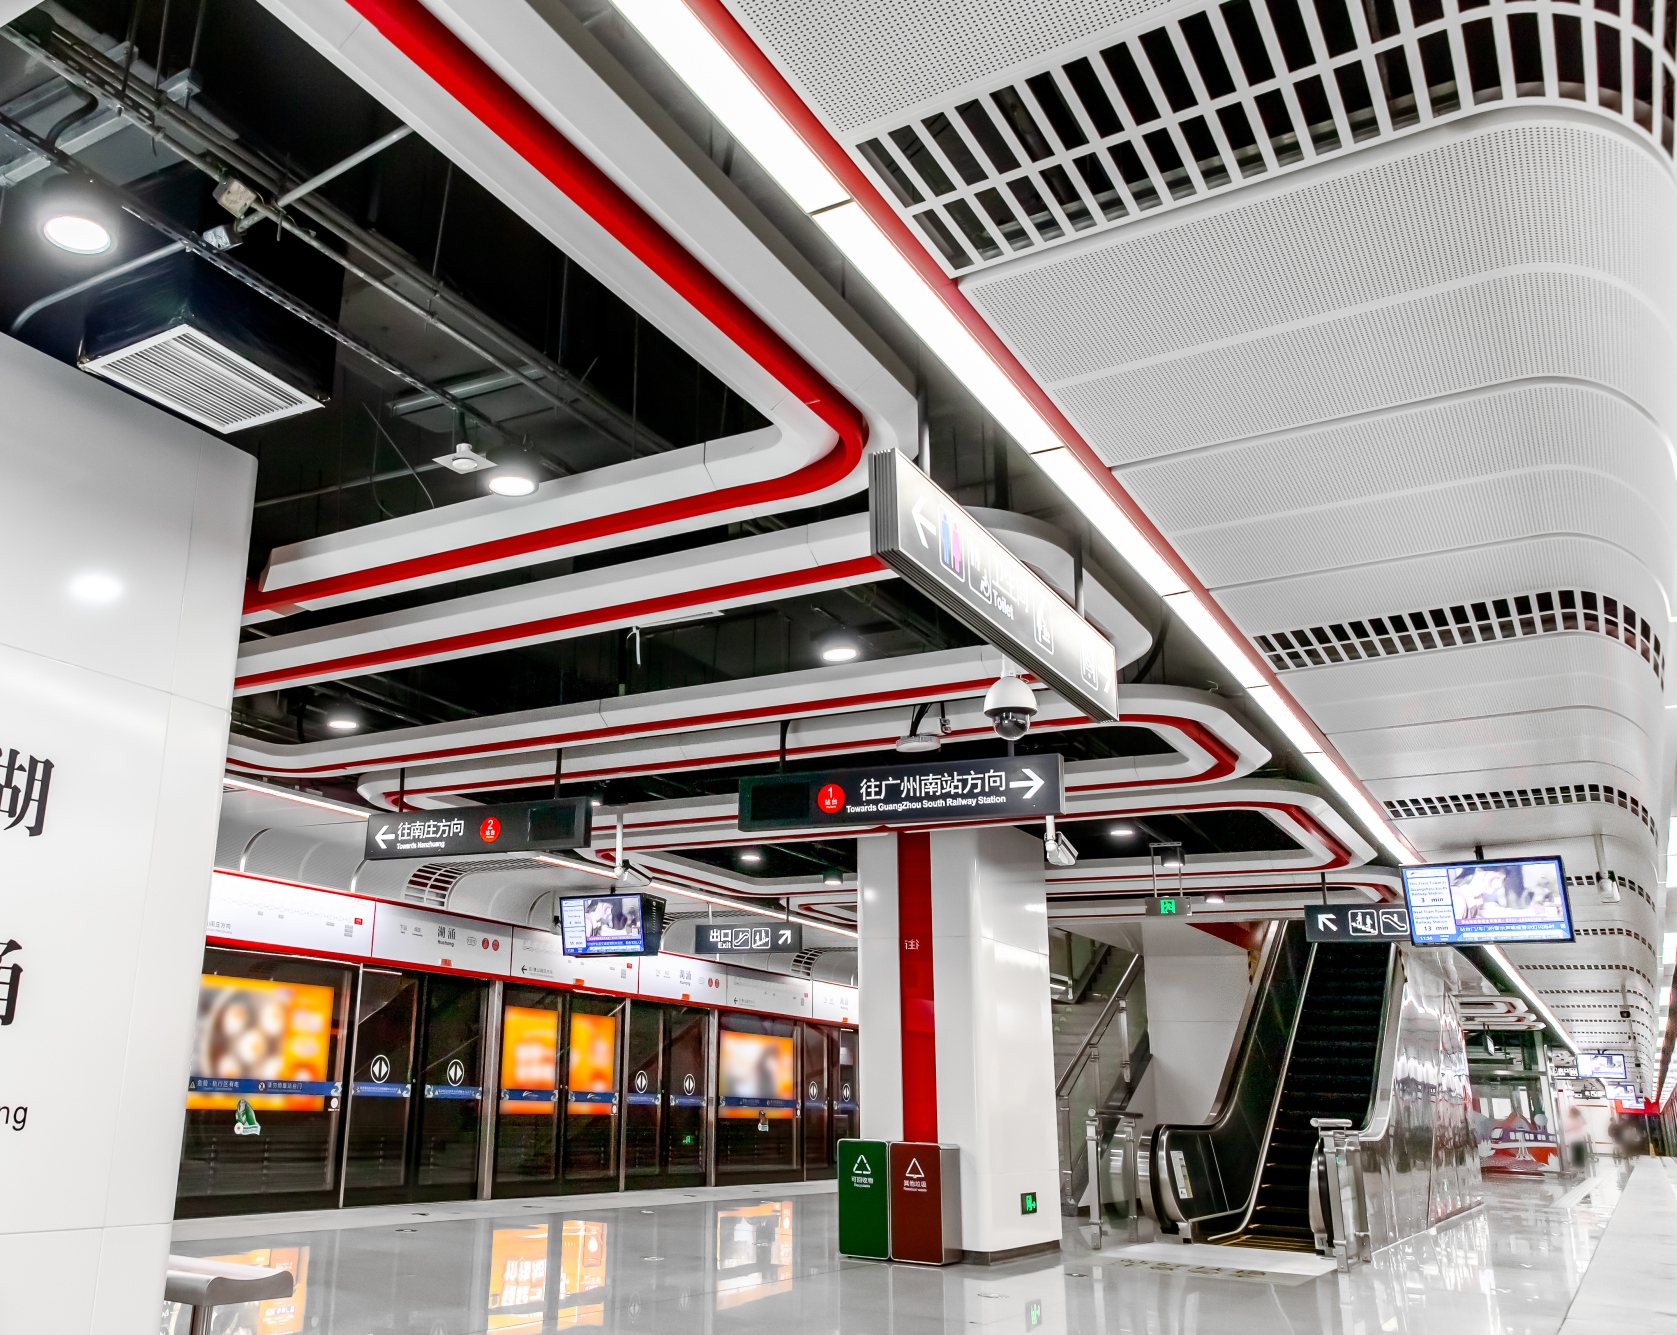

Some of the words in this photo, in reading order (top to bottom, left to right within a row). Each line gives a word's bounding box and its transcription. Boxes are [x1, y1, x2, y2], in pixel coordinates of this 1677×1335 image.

[992, 588, 1015, 620] Toilet
[827, 786, 833, 799] 1
[859, 769, 1006, 801] 往广州南站方向
[846, 803, 877, 814] Towards
[878, 800, 922, 812] GuangZhou
[922, 799, 946, 809] South
[946, 797, 977, 807] Railway
[977, 794, 1007, 804] Station
[397, 818, 465, 841] 往南庄方向
[487, 819, 494, 830] 2
[709, 929, 732, 942] 出口
[717, 941, 732, 949] Exit
